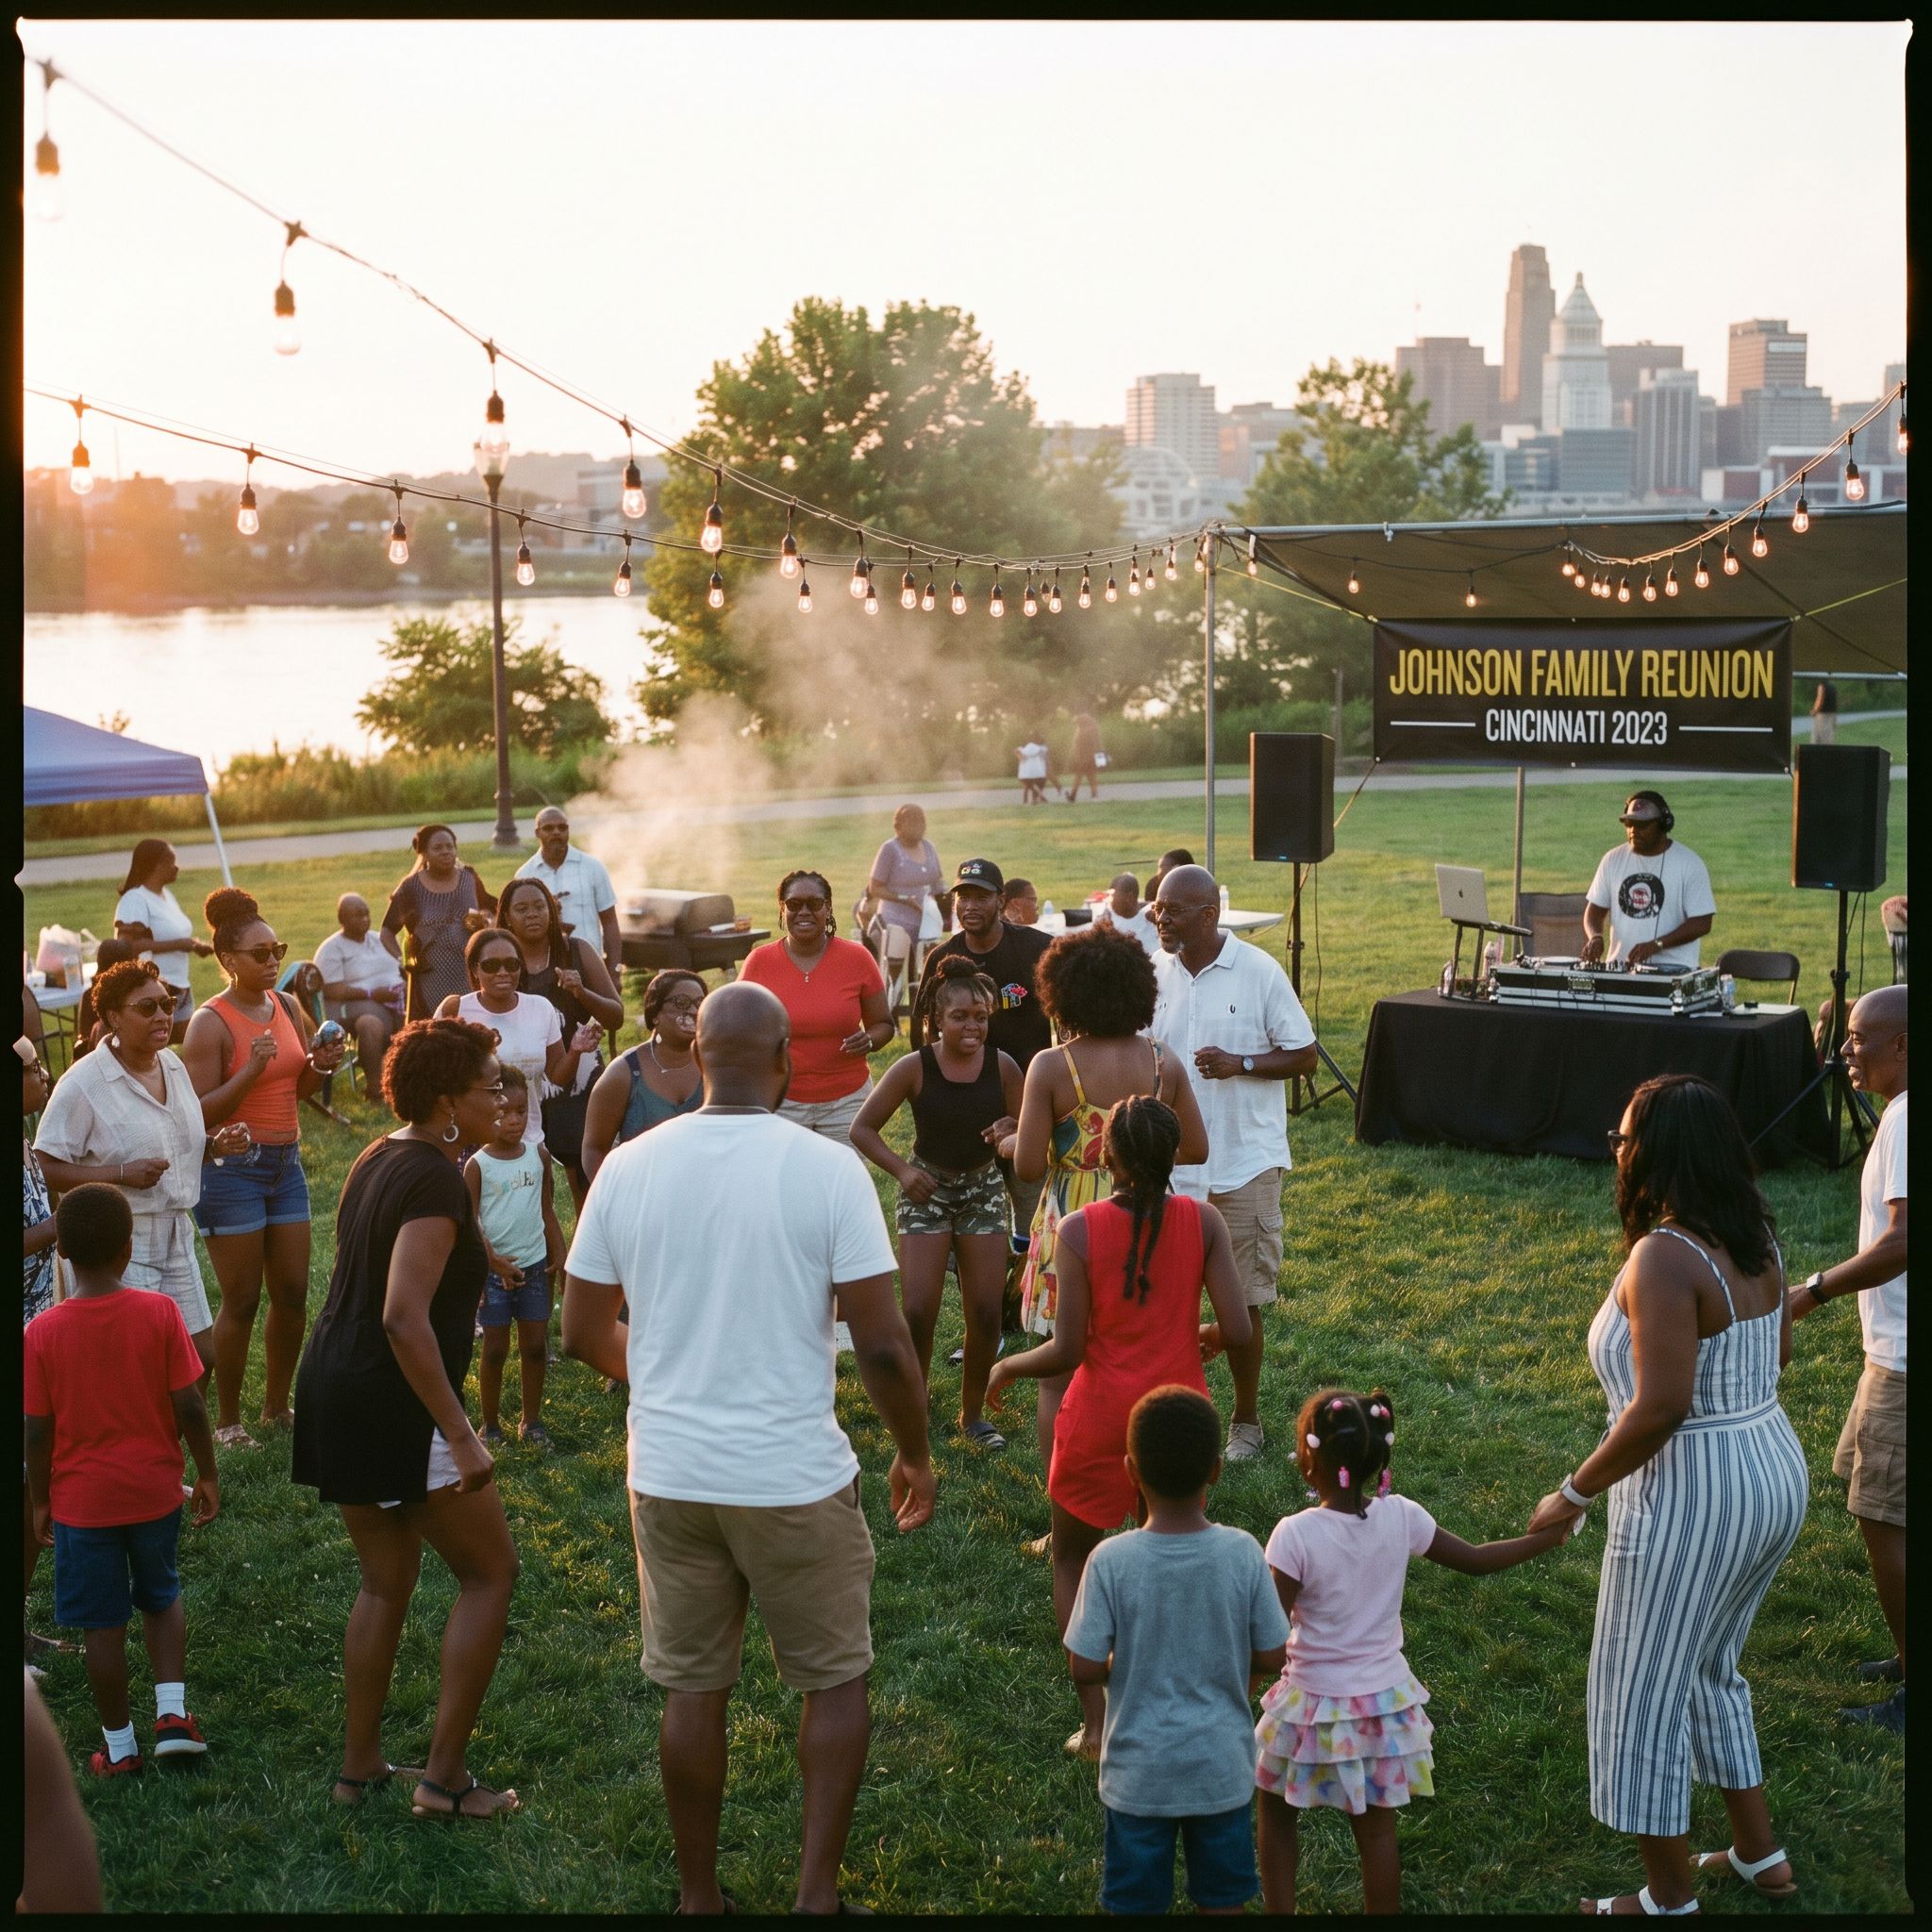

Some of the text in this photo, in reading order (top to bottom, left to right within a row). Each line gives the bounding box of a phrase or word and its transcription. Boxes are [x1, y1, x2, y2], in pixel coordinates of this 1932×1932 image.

[1390, 649, 1773, 698] JOHNSON FAMILY REUNION
[1487, 709, 1667, 744] CINCINNATI 2023
